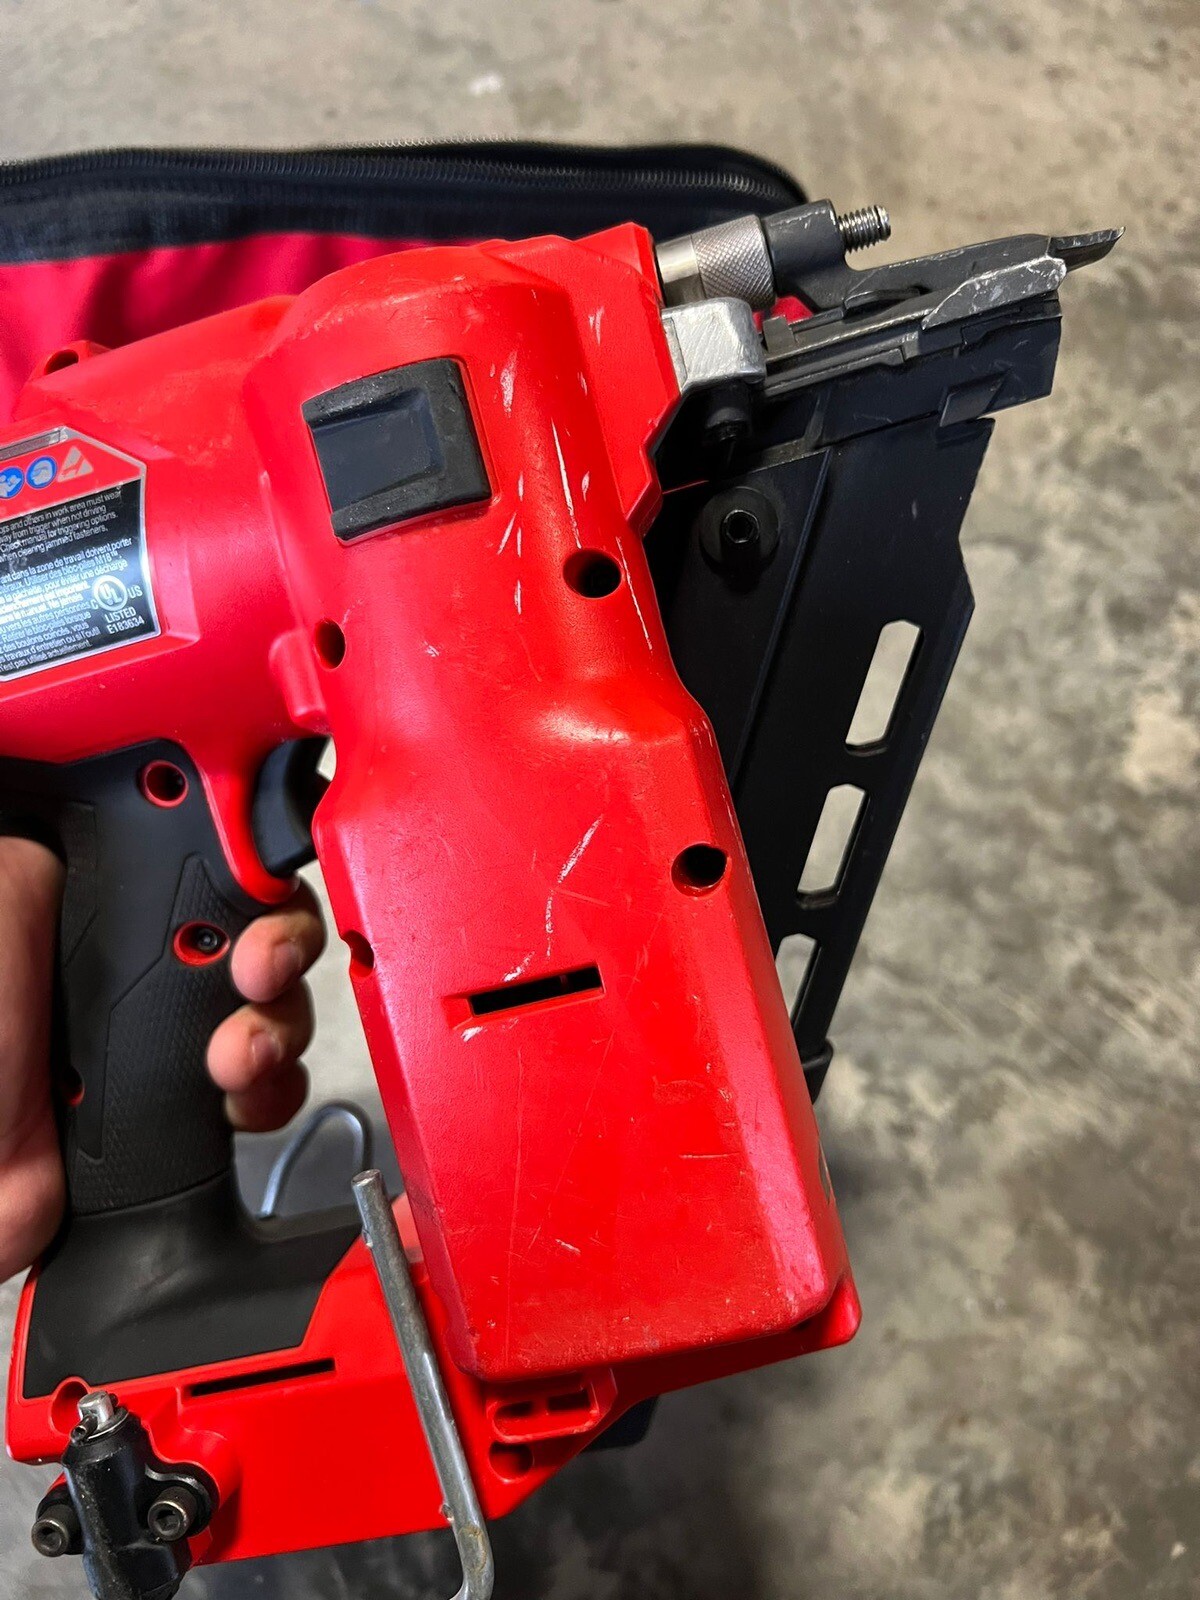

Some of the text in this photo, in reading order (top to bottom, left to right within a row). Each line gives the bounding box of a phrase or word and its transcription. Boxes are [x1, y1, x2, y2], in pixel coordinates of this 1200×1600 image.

[51, 505, 69, 517] work
[69, 501, 85, 511] area
[85, 495, 104, 506] must
[103, 490, 121, 501] wear
[11, 527, 28, 538] from
[28, 521, 51, 536] trigger
[50, 515, 70, 526] when
[70, 511, 82, 520] not
[82, 504, 106, 519] driving
[56, 519, 90, 536] triggering
[10, 567, 29, 580] dans
[28, 565, 36, 574] la
[36, 561, 54, 572] zone
[53, 557, 63, 567] de
[63, 550, 85, 564] travail
[84, 542, 111, 557] doivent
[111, 536, 133, 551] porter
[126, 583, 143, 599] US
[104, 605, 137, 623] LISTED
[106, 614, 145, 634] E183634
